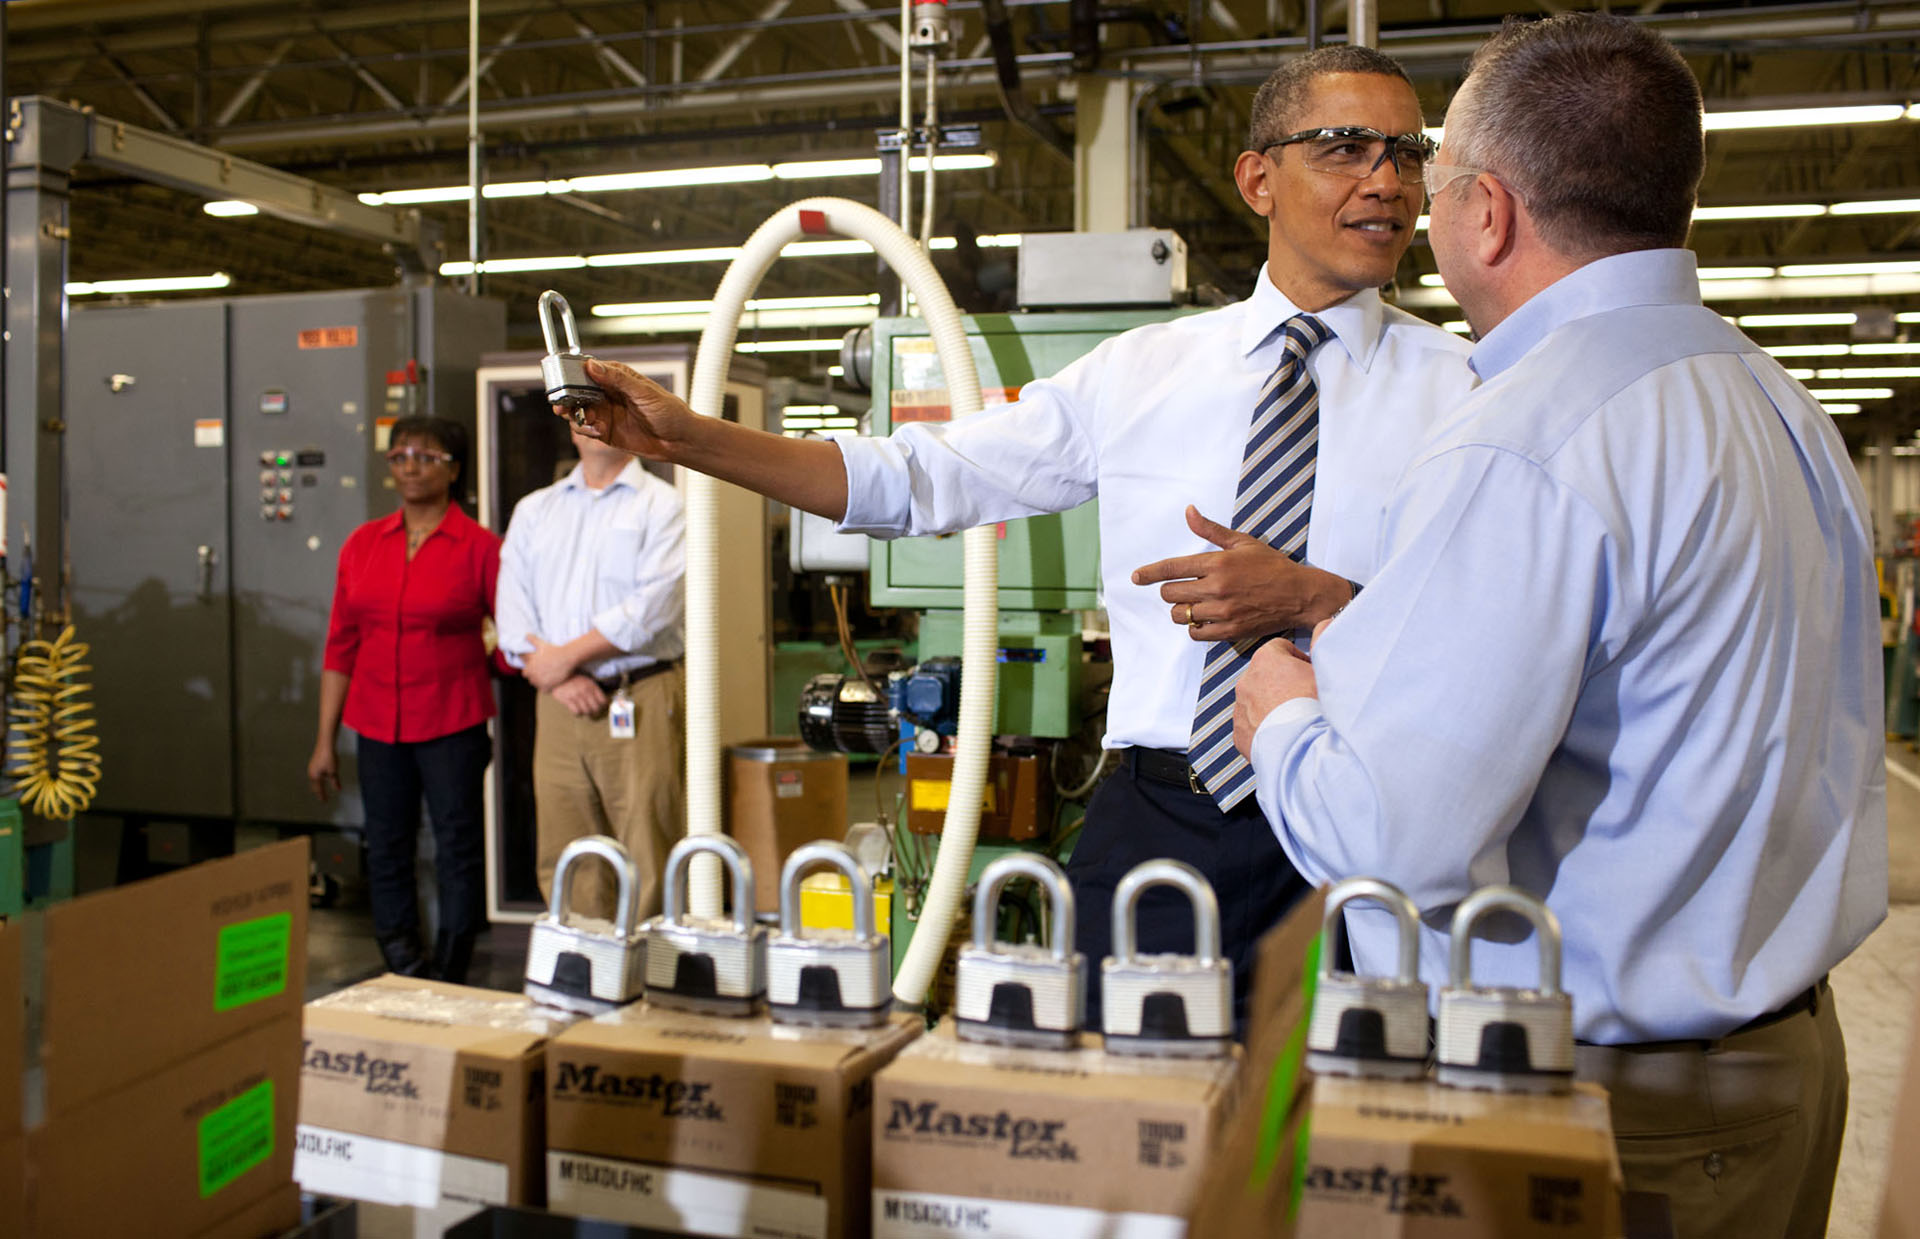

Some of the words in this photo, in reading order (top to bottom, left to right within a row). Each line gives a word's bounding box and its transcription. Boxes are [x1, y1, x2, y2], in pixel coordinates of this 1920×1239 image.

[365, 1078, 420, 1100] Lock
[554, 1062, 711, 1102] Master
[662, 1100, 725, 1121] Lock
[885, 1099, 1067, 1142] Master
[1008, 1140, 1081, 1163] Lock
[1302, 1164, 1448, 1197] aster
